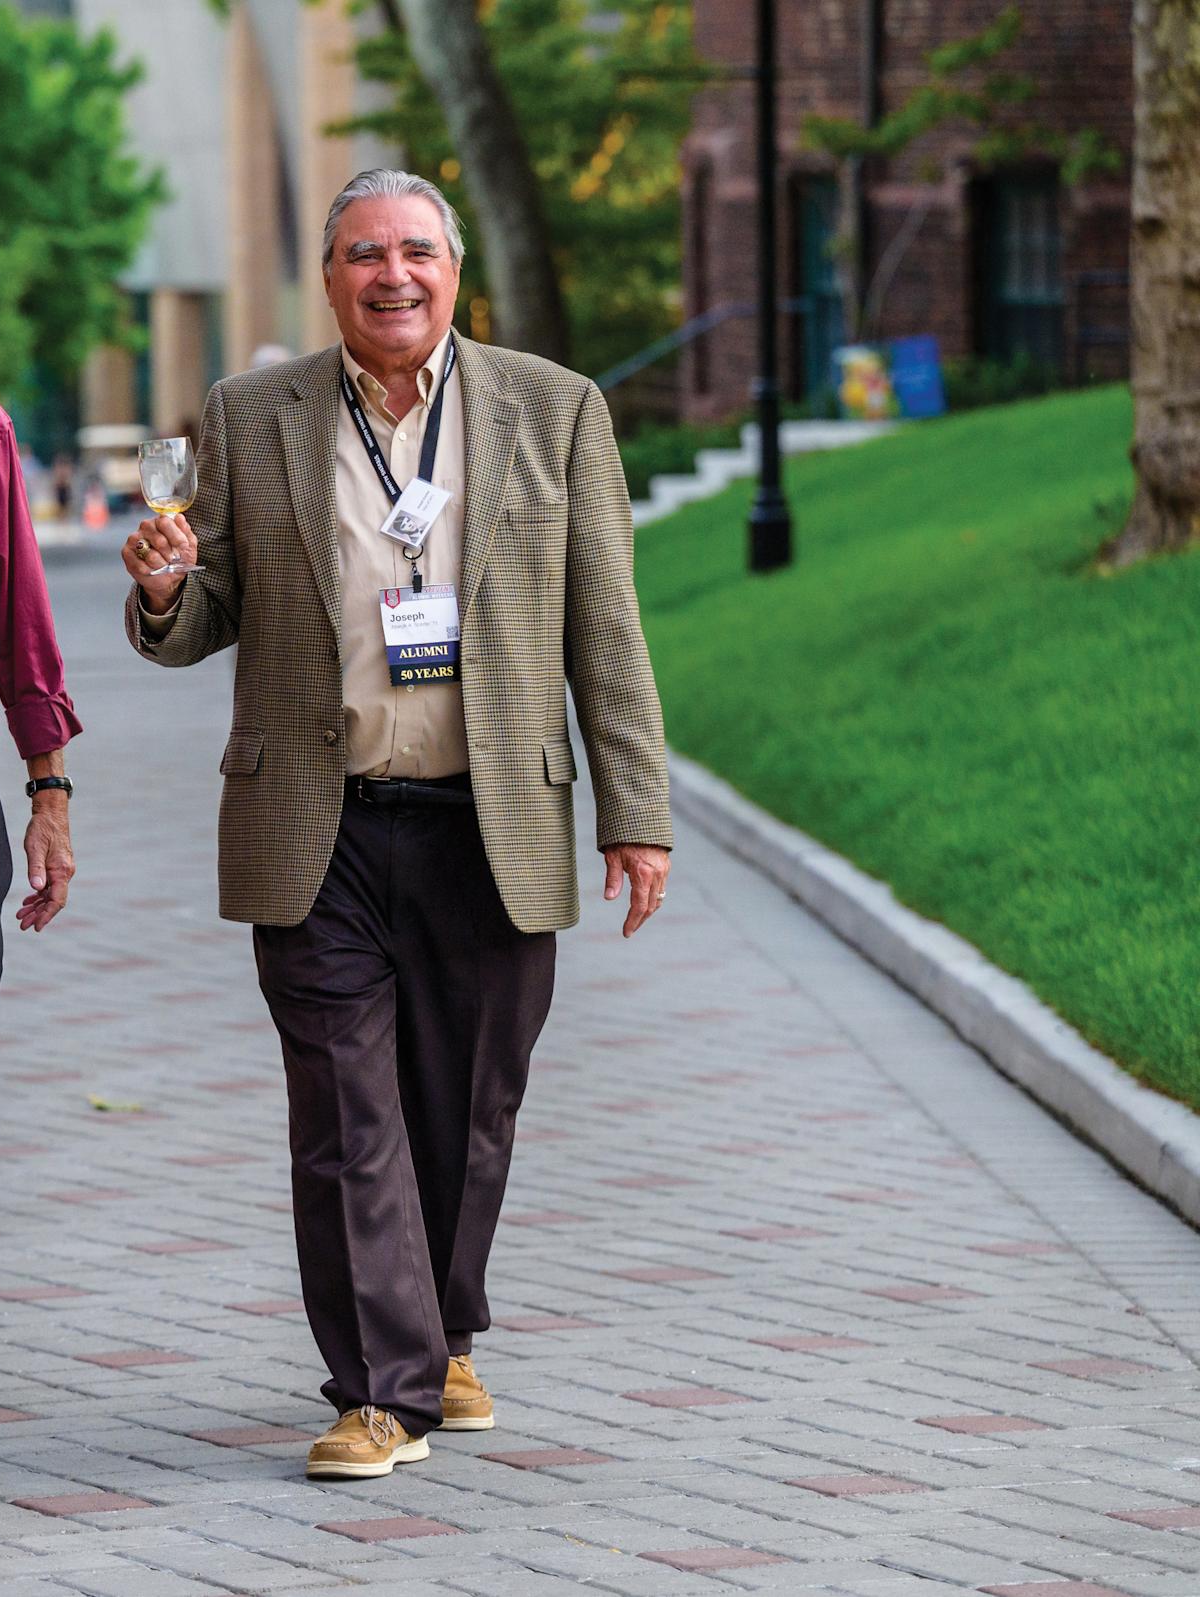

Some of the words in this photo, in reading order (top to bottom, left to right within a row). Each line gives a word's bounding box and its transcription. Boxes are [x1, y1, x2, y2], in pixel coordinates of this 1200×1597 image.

[353, 407, 366, 430] STEVENS
[362, 428, 375, 449] ALUMNI
[373, 454, 387, 476] STEVENS
[382, 475, 397, 496] ALUMNI
[390, 612, 425, 622] Joseph
[399, 645, 448, 659] ALUMNI
[401, 669, 413, 680] 50
[415, 666, 454, 679] YEARS
